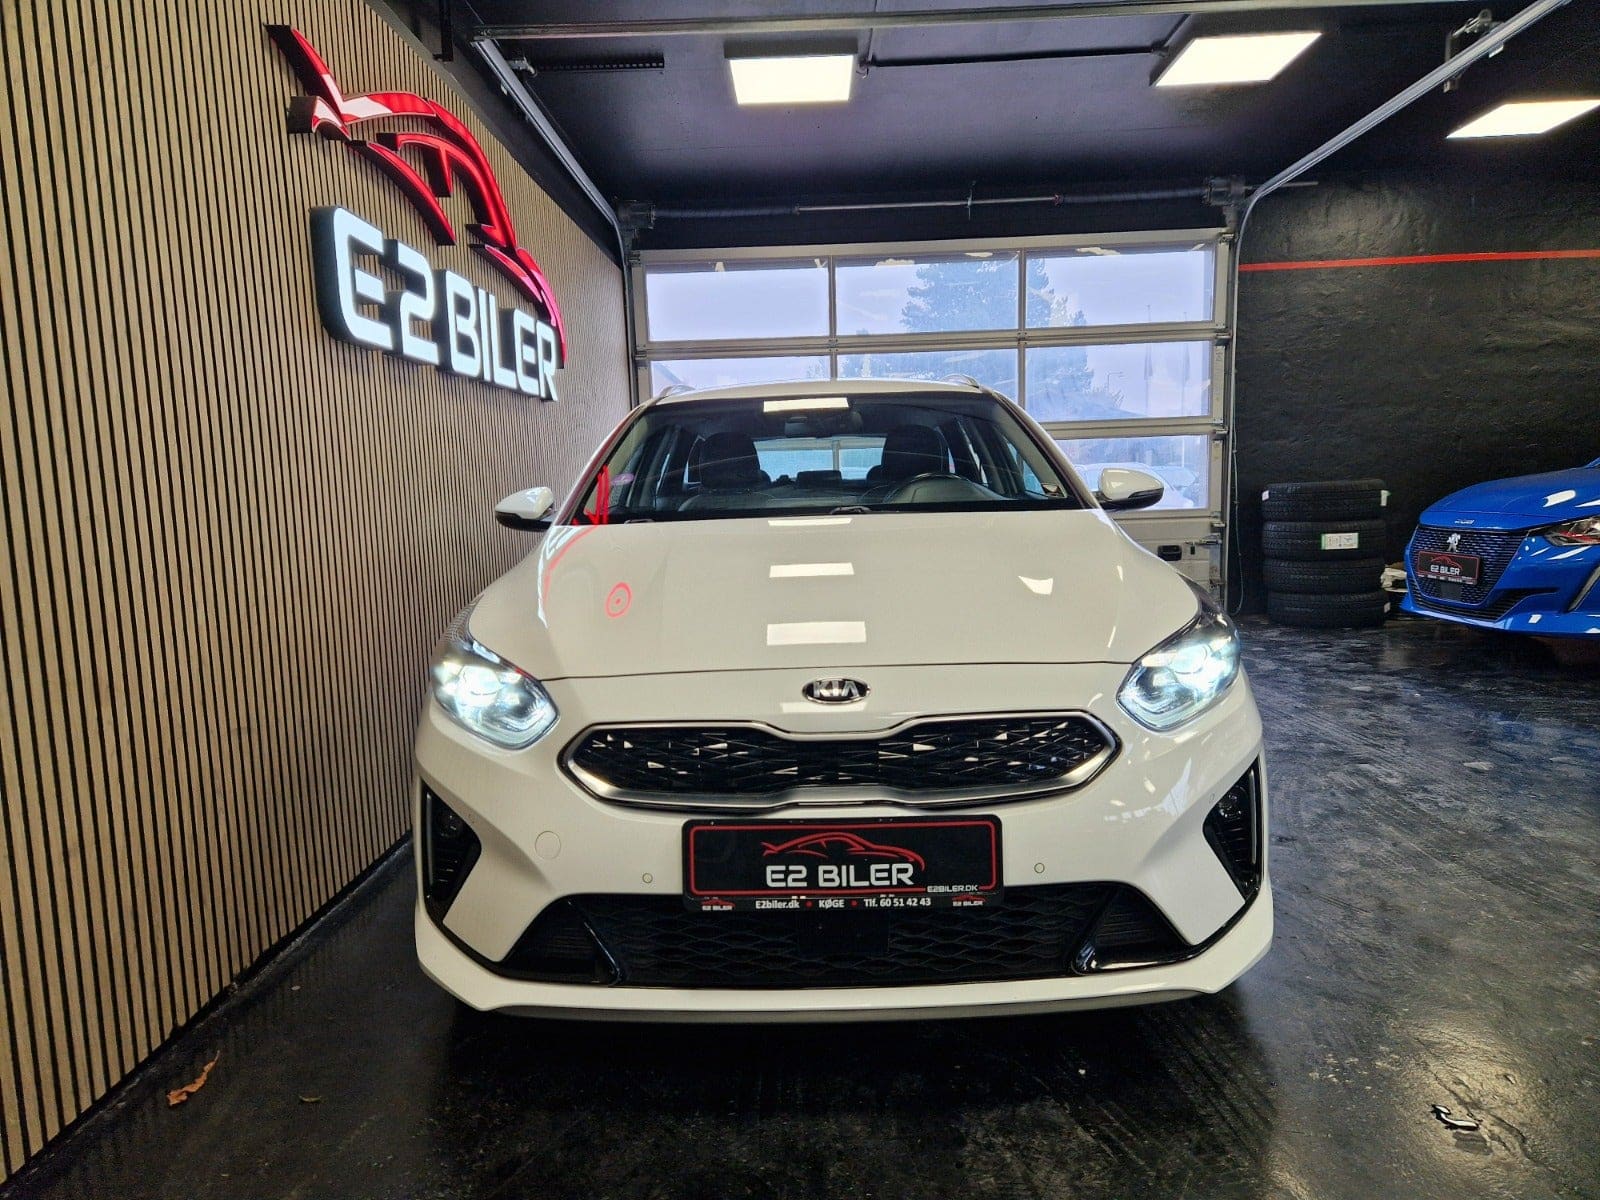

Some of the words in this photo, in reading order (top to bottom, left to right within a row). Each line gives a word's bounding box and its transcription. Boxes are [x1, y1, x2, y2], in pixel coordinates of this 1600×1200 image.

[331, 206, 440, 366] E2
[445, 270, 558, 401] BILER
[812, 679, 860, 698] KIA
[766, 865, 807, 887] E2
[818, 863, 914, 887] BILER
[755, 900, 800, 909] E2biler.dk
[818, 898, 845, 909] KØGE
[880, 898, 891, 907] 60
[893, 897, 904, 907] 51
[906, 897, 917, 906] 42
[919, 896, 931, 906] 43
